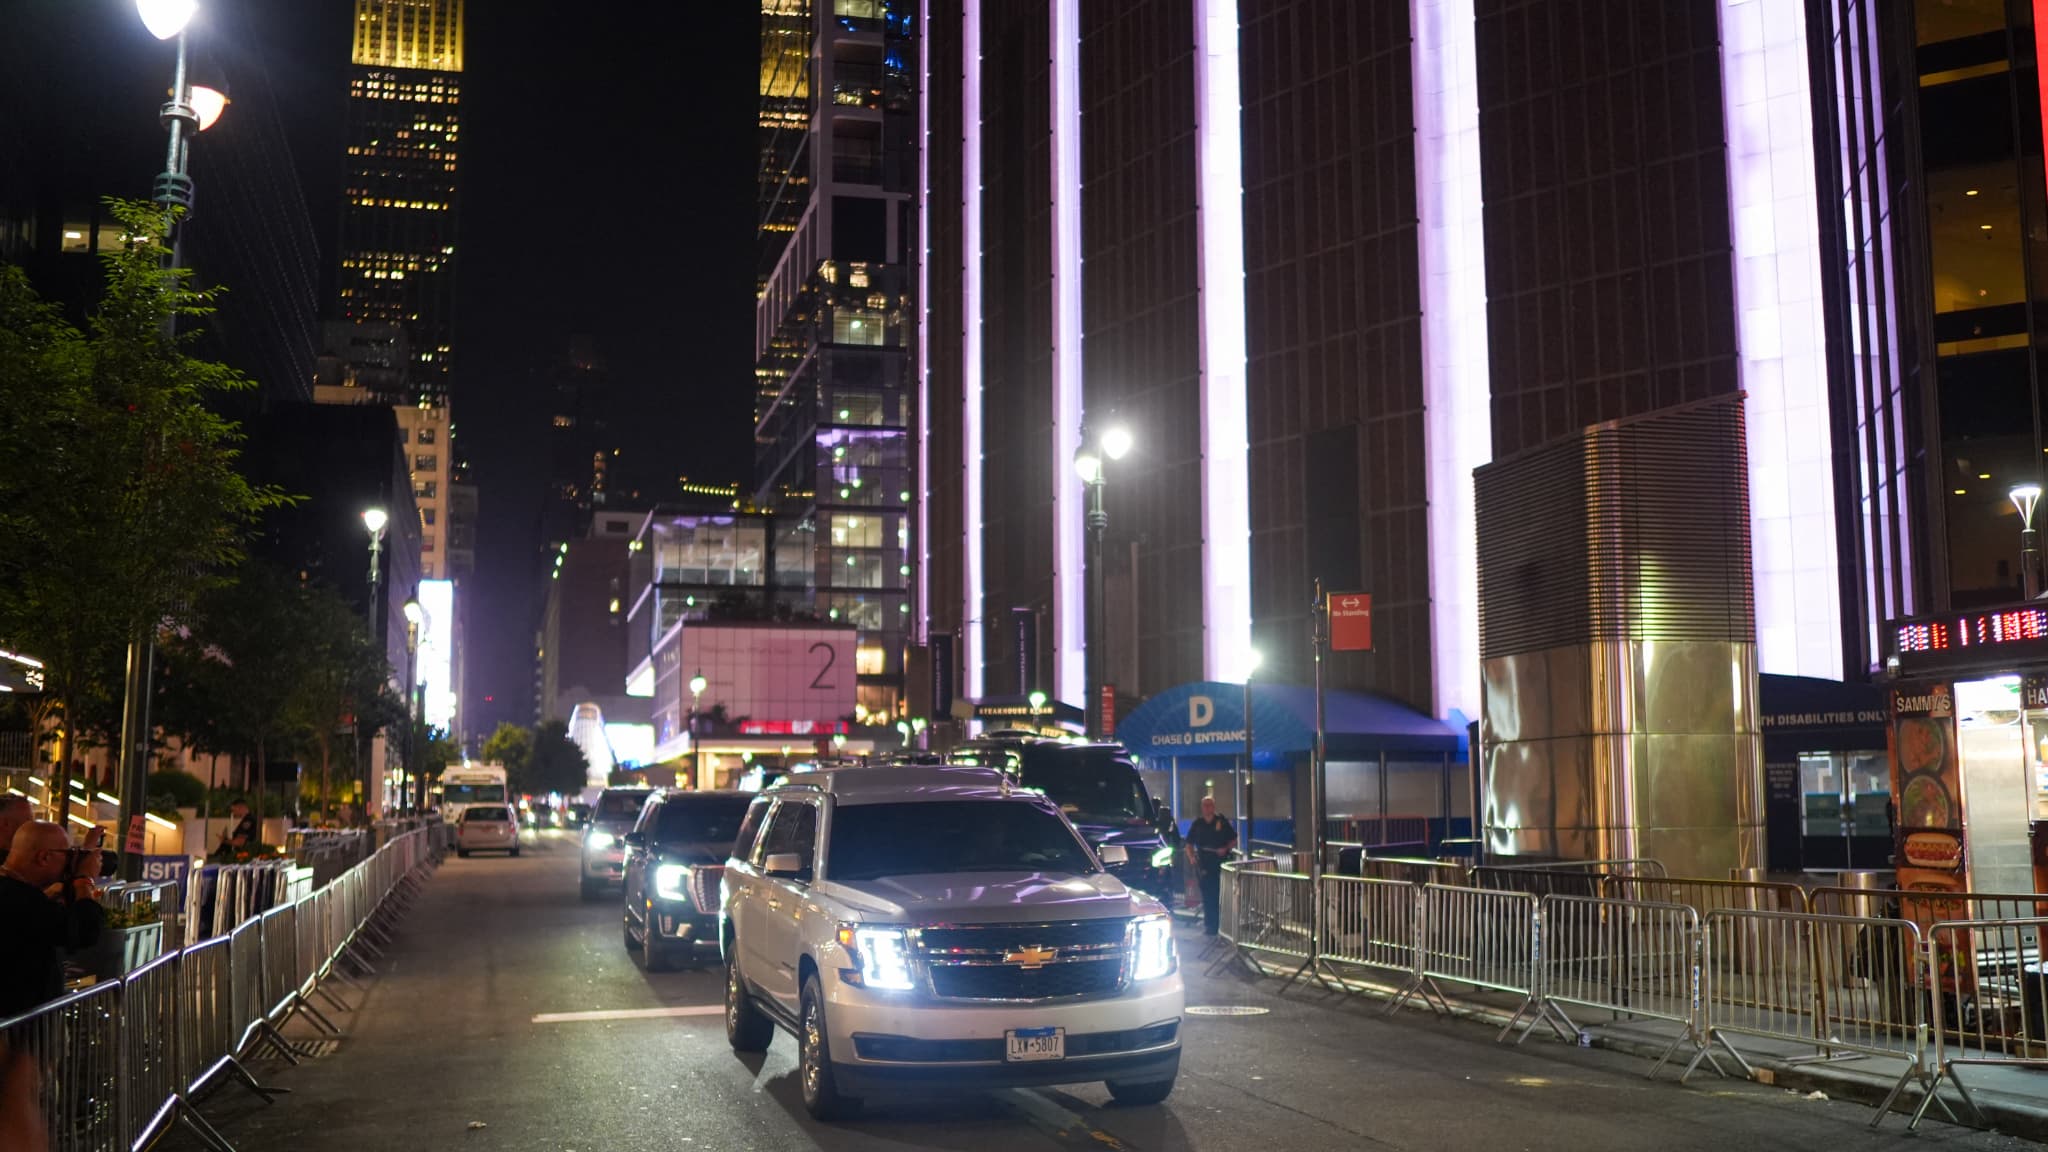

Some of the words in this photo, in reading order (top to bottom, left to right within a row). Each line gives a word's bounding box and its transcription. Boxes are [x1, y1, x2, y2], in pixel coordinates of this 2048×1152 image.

[809, 642, 836, 689] 2
[1896, 694, 1951, 712] SAMMY'S
[2027, 688, 2048, 705] HA
[1189, 696, 1214, 727] D
[1778, 712, 1855, 725] DISABILITIES
[1152, 734, 1182, 746] CHASE
[1195, 729, 1254, 744] ENTRANC
